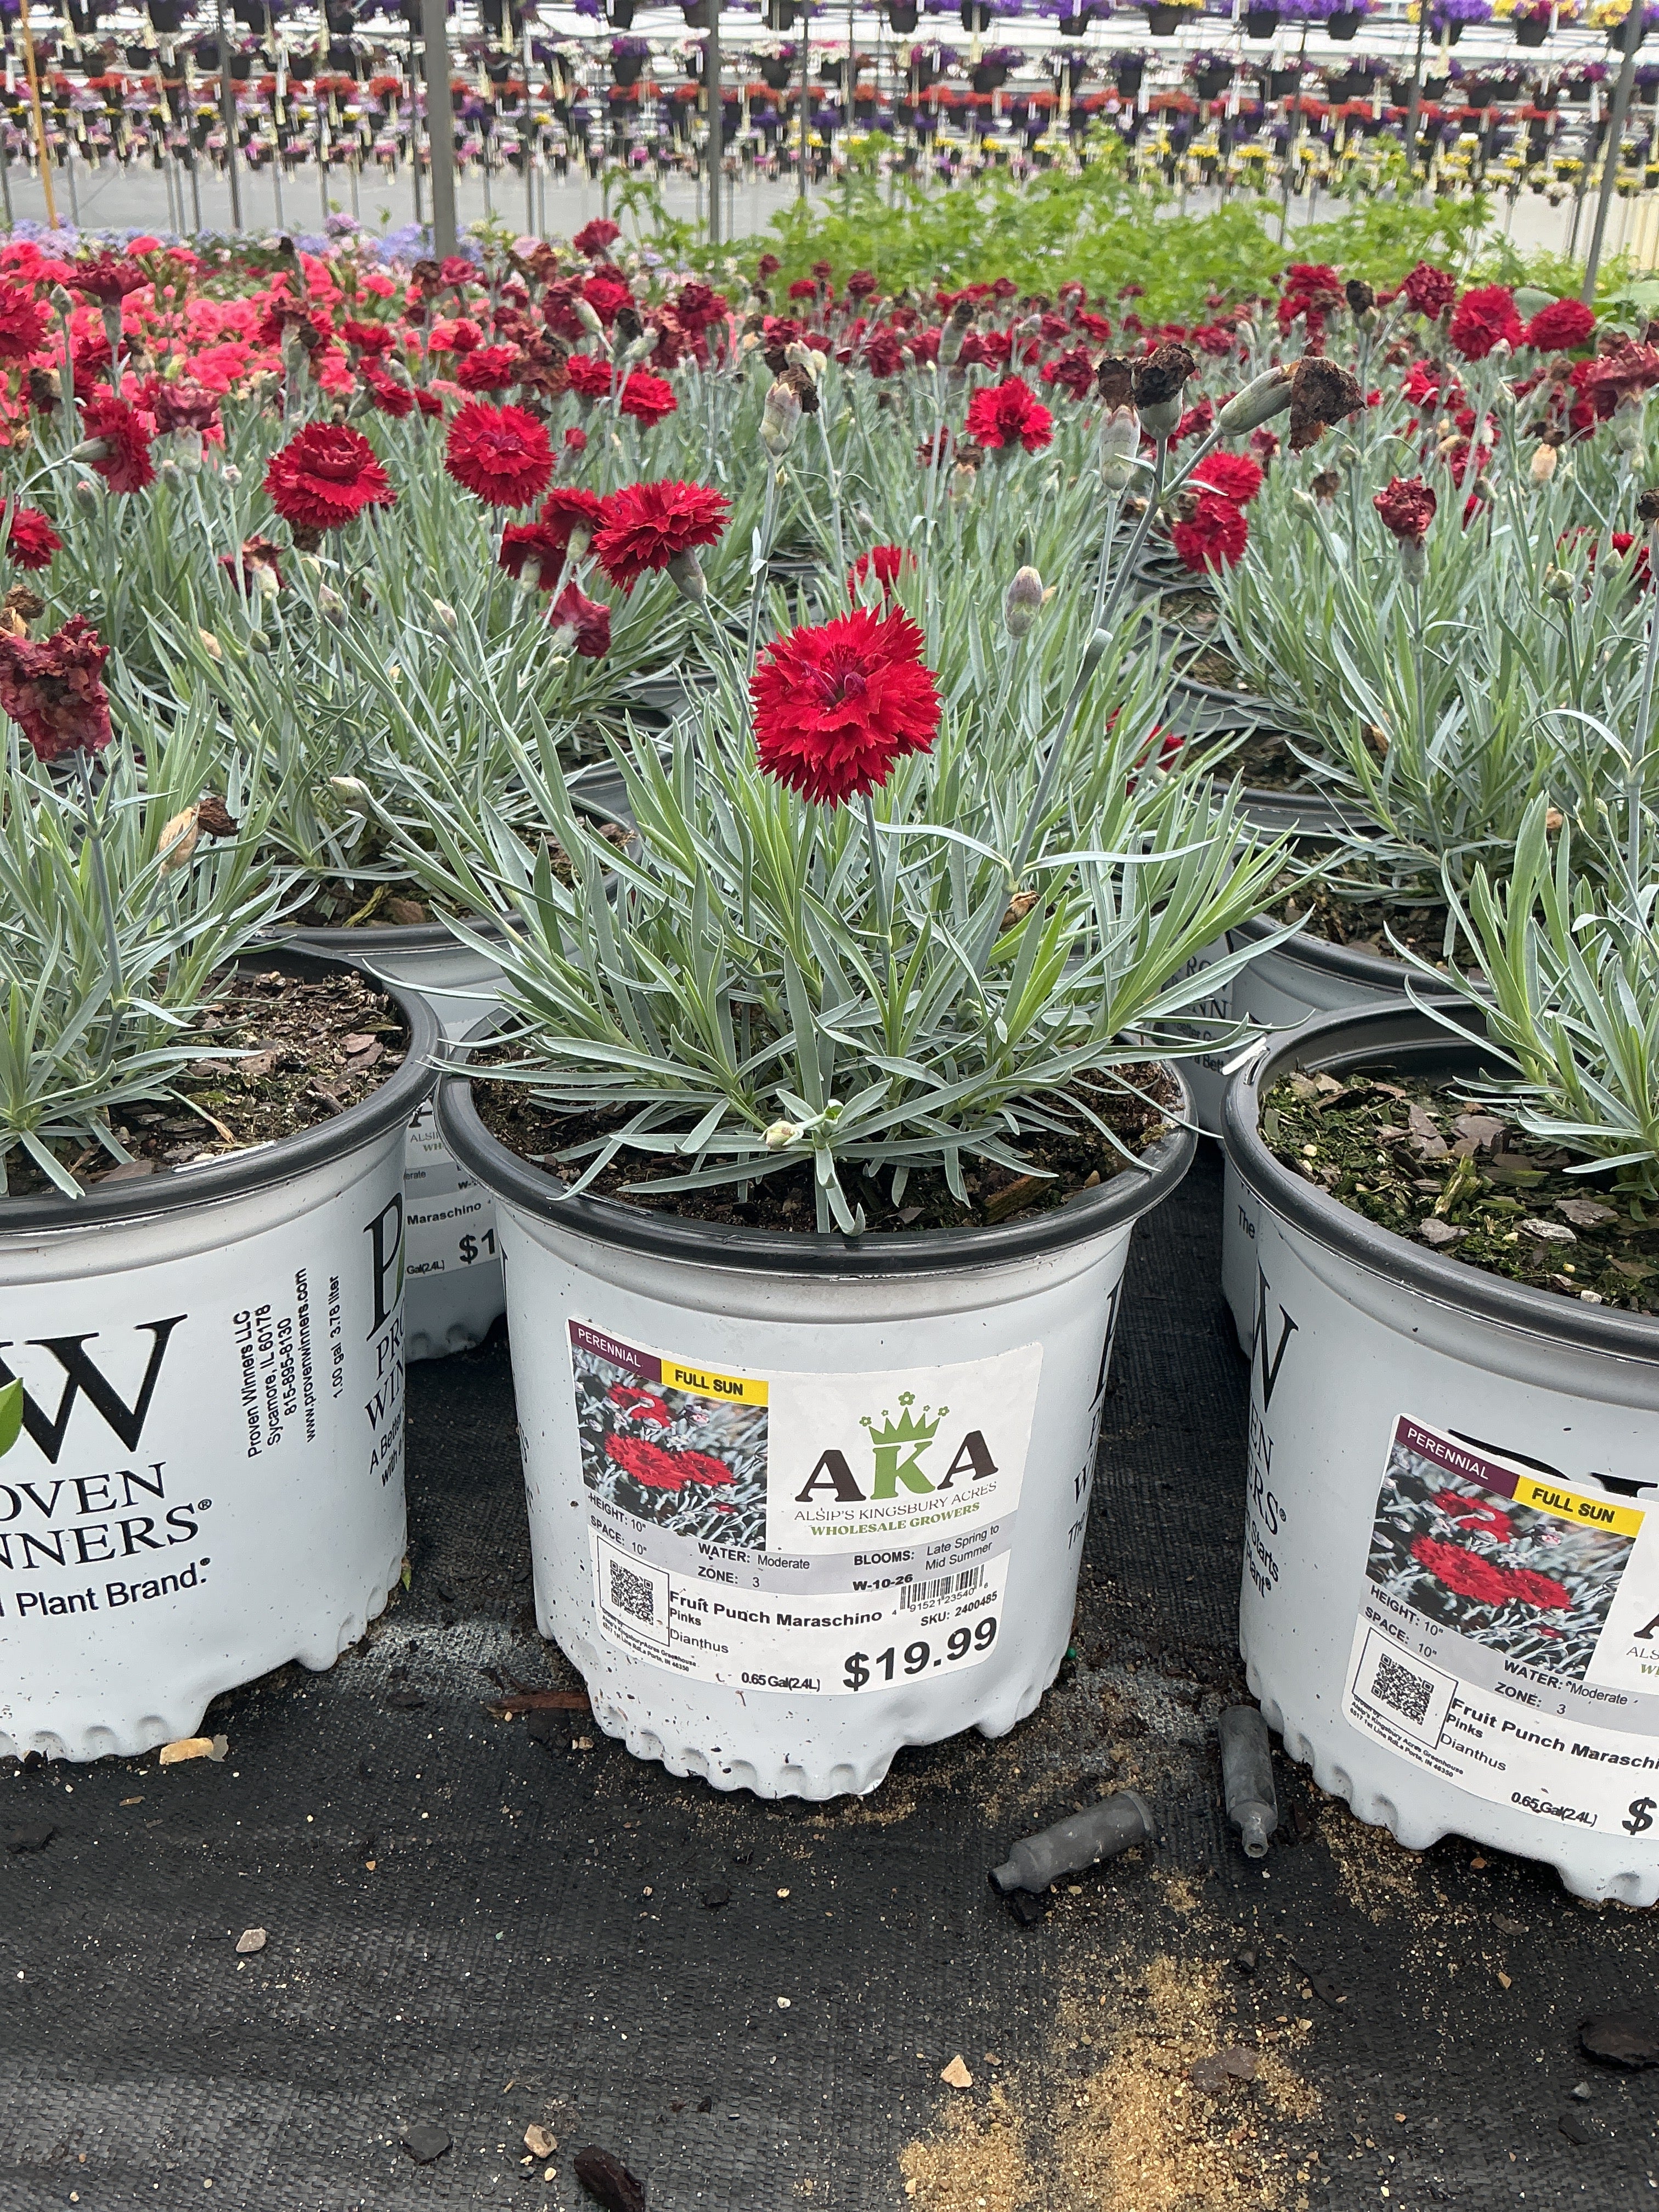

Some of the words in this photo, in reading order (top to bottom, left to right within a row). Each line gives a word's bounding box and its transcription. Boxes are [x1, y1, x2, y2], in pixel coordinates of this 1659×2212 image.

[407, 1202, 482, 1226] Maraschino
[328, 1275, 340, 1305] liter
[233, 1310, 252, 1344] LLC
[253, 1304, 274, 1351] 60178
[329, 1304, 341, 1339] 3.78
[259, 1351, 275, 1369] IL
[295, 1268, 317, 1443] www.provenwinners.com
[330, 1342, 345, 1365] gal
[578, 1327, 641, 1368] PERENNIAL
[240, 1344, 257, 1407] Winners
[276, 1317, 297, 1416] 815-895-8130
[332, 1367, 343, 1399] 1.00
[675, 1369, 710, 1390] FULL
[713, 1379, 743, 1396] SUN
[264, 1368, 284, 1446] Sycamore,
[247, 1405, 263, 1458] Proven
[794, 1430, 999, 1502] AKA
[1407, 1427, 1489, 1480] PERENNIAL
[589, 1492, 628, 1525] HEIGHT:
[859, 1497, 949, 1520] KINGSBURY
[951, 1481, 997, 1505] ACRES
[1532, 1487, 1573, 1513] FULL
[1578, 1502, 1616, 1523] SUN
[590, 1515, 625, 1546] SPACE:
[810, 1520, 906, 1536] WHOLESALE
[909, 1502, 980, 1527] GROWERS
[698, 1542, 751, 1564] WATER:
[758, 1554, 810, 1570] Moderate
[854, 1550, 915, 1566] BLOOMS:
[927, 1543, 951, 1556] Late
[955, 1530, 988, 1549] Spring
[990, 1525, 999, 1535] to
[926, 1556, 946, 1570] Mid
[949, 1542, 992, 1565] Summer
[698, 1566, 738, 1584] ZONE:
[752, 1577, 760, 1588] 3
[853, 1573, 913, 1592] W-10-26
[15, 1587, 99, 1617] Plant
[670, 1590, 709, 1613] Fruit
[714, 1602, 770, 1624] Punch
[776, 1612, 882, 1627] Maraschino
[670, 1607, 702, 1626] Pinks
[920, 1611, 950, 1627] SKU:
[955, 1590, 997, 1617] 2400485
[1370, 1585, 1420, 1626] HEIGHT:
[670, 1628, 729, 1654] Dianthus
[1365, 1606, 1409, 1645] SPACE:
[843, 1616, 997, 1692] $19.99
[741, 1672, 766, 1686] 0.65
[1504, 1659, 1564, 1690] WATER:
[1570, 1683, 1628, 1705] Moderate
[1494, 1681, 1542, 1707] ZONE:
[1556, 1703, 1566, 1715] 3
[1446, 1713, 1483, 1739] Pinks
[1451, 1697, 1498, 1728] Fruit
[1501, 1720, 1566, 1752] Punch
[1440, 1733, 1507, 1771] Dianthus
[1511, 1792, 1539, 1809] 0.65
